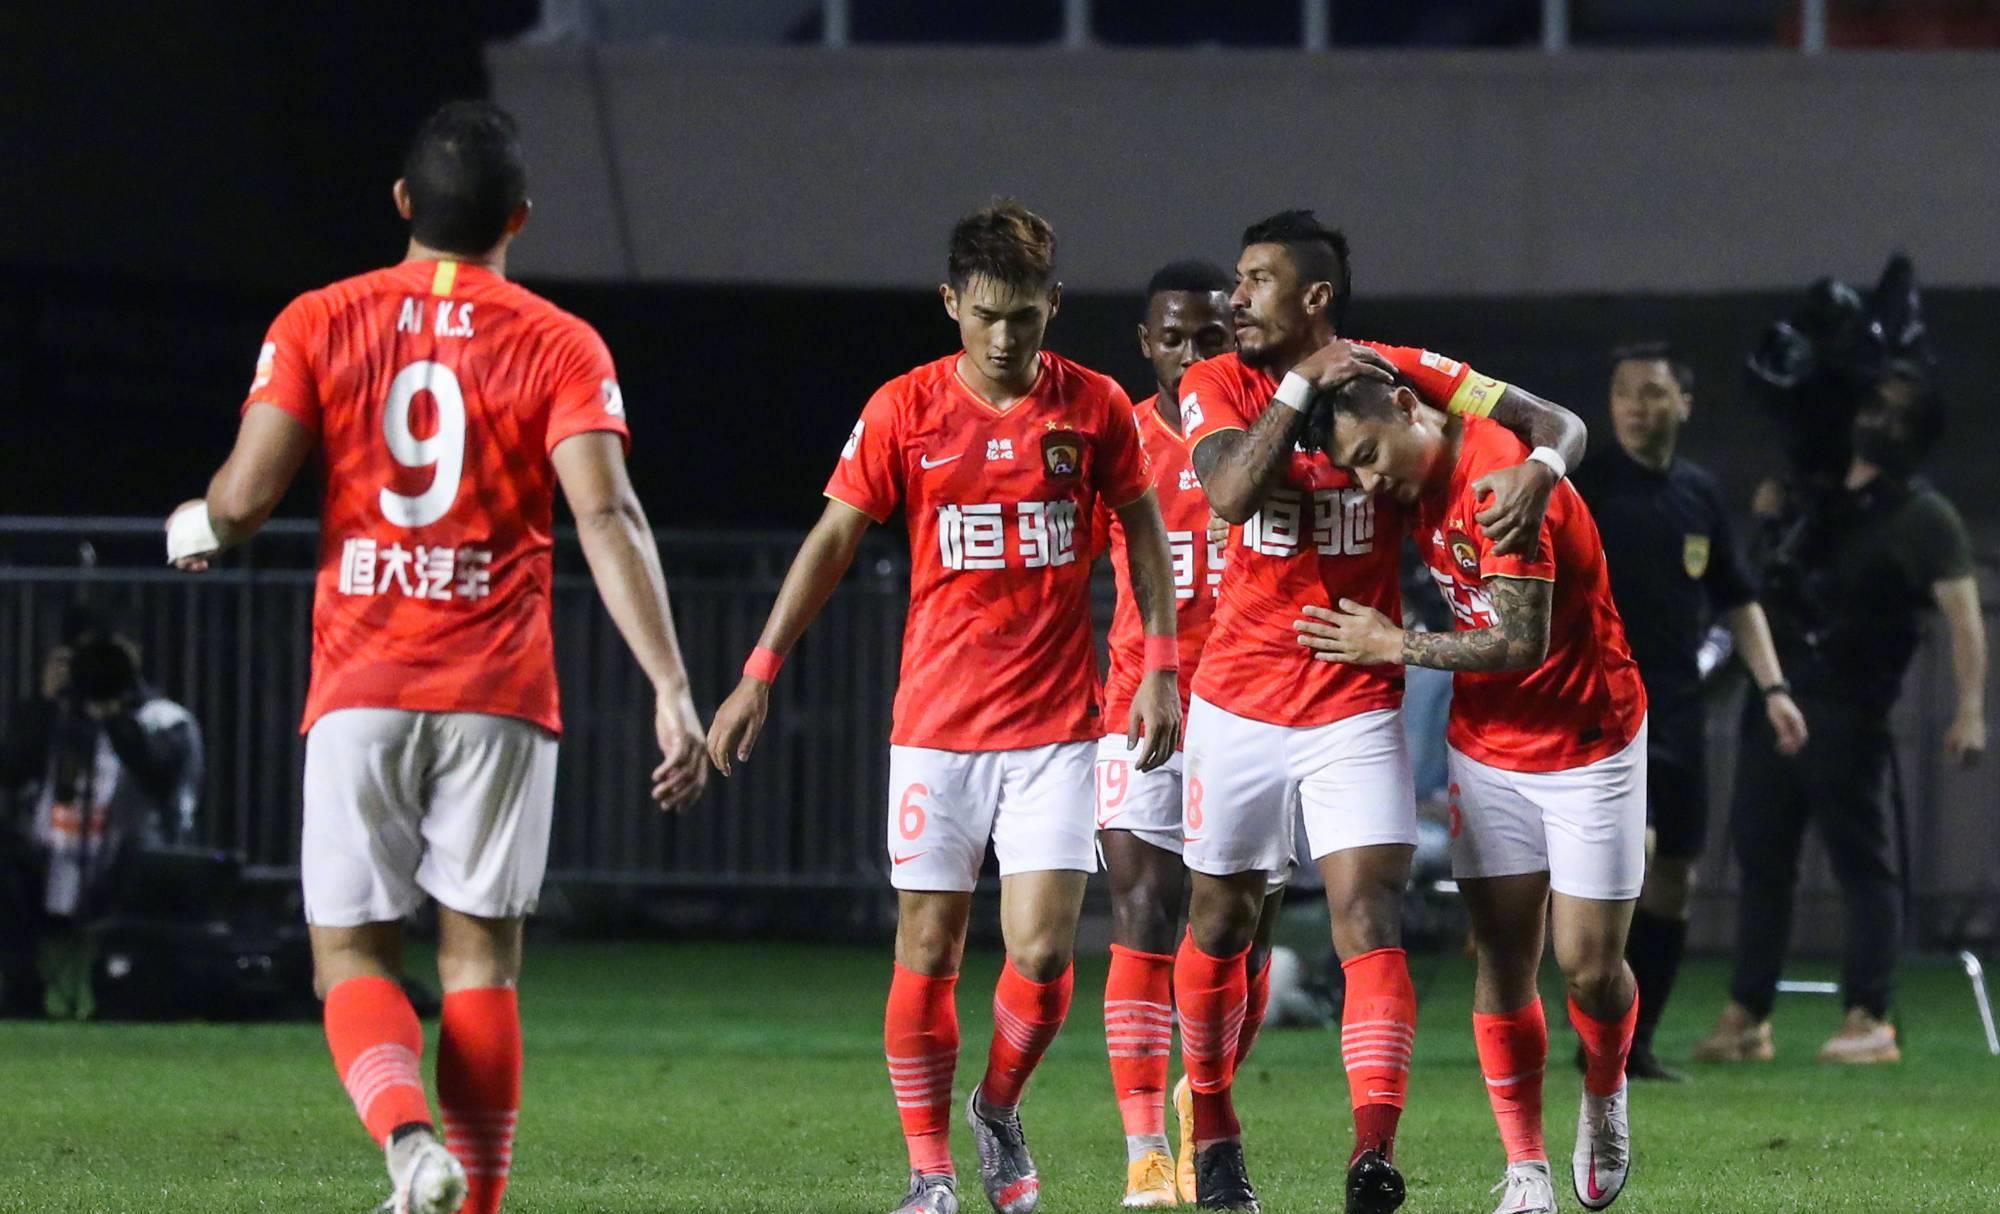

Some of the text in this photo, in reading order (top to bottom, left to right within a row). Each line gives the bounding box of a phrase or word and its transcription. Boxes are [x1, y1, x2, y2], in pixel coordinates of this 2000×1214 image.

[436, 300, 475, 337] K.S.
[379, 360, 466, 527] 9
[937, 501, 1077, 570] 恒驰
[338, 537, 492, 601] 恒大汽车
[899, 783, 928, 842] 6
[1187, 776, 1203, 829] 8
